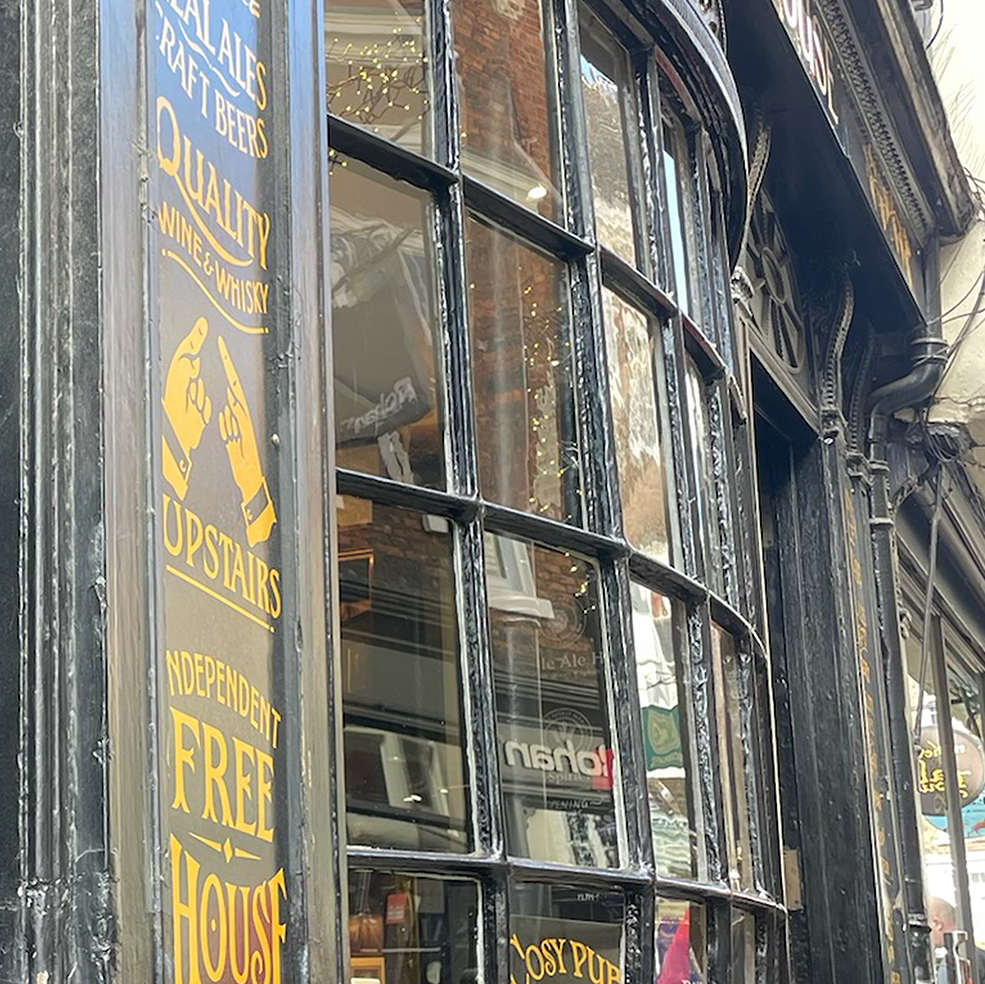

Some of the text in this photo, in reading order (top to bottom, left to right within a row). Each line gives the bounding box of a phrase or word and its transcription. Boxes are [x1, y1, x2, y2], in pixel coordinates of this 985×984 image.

[156, 10, 268, 159] RAFT BEERS
[218, 18, 266, 110] ALES
[156, 96, 270, 270] QUALITY
[158, 202, 202, 267] WINE
[215, 260, 269, 314] WHISKY
[163, 494, 281, 619] UPSTAIRS
[166, 649, 281, 749] NDEPENDENT
[169, 705, 275, 843] FREE
